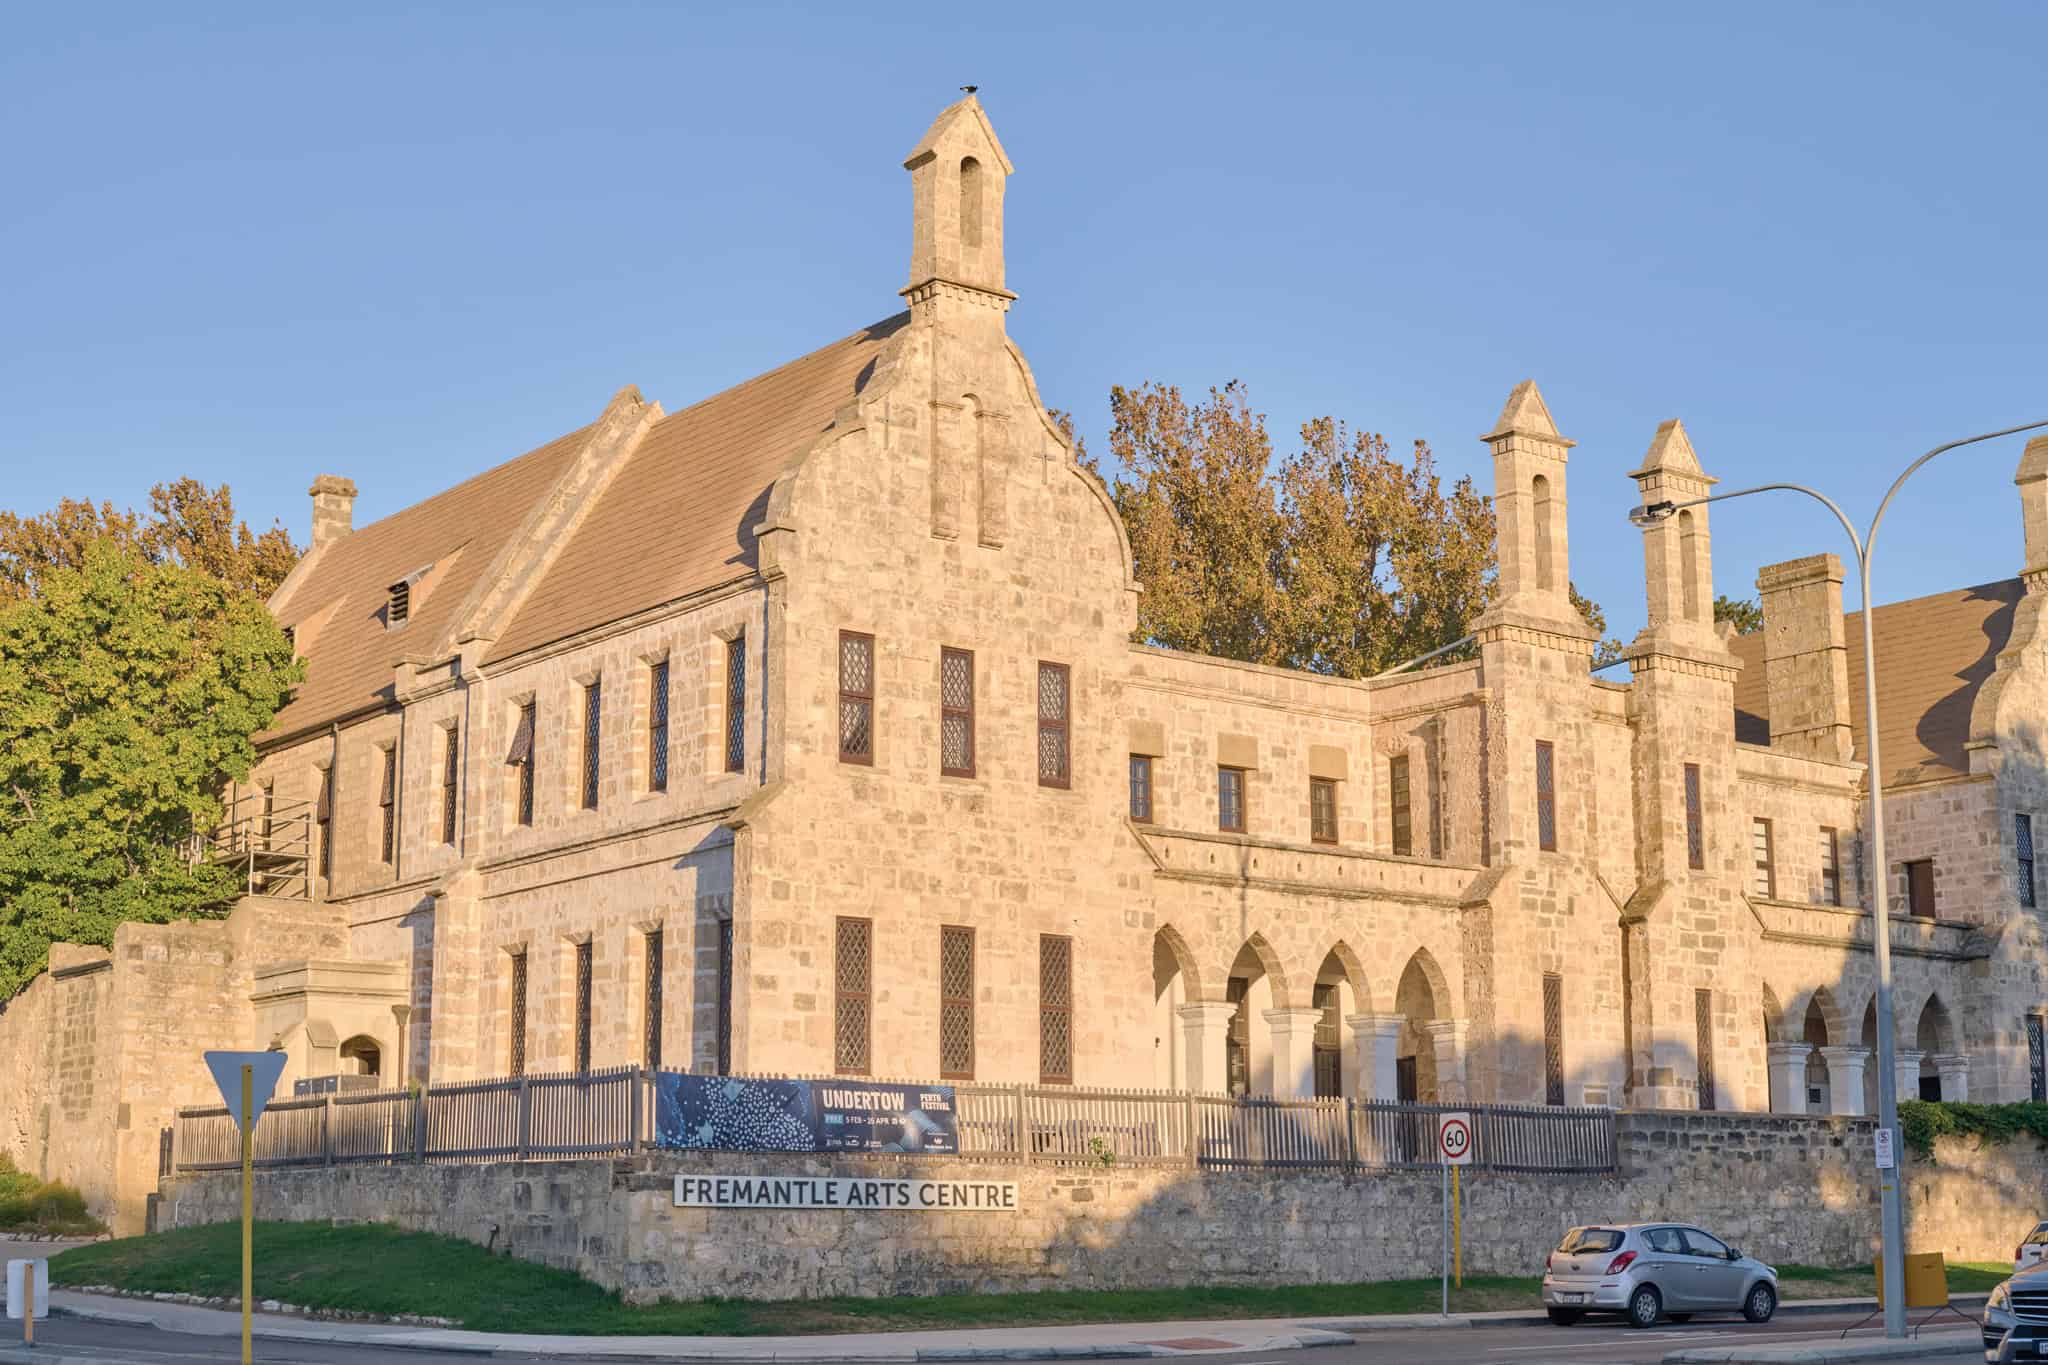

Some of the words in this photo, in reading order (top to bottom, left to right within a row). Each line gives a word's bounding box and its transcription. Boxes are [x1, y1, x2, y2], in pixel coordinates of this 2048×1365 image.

[823, 1089, 905, 1110] UNDERTOW
[920, 1093, 941, 1101] PERTH
[921, 1101, 950, 1110] FESTIVAL
[1446, 1130, 1464, 1147] 60
[682, 1178, 838, 1205] FREMANTLE
[846, 1182, 910, 1207] ARTS
[919, 1183, 1015, 1208] CENTRE
